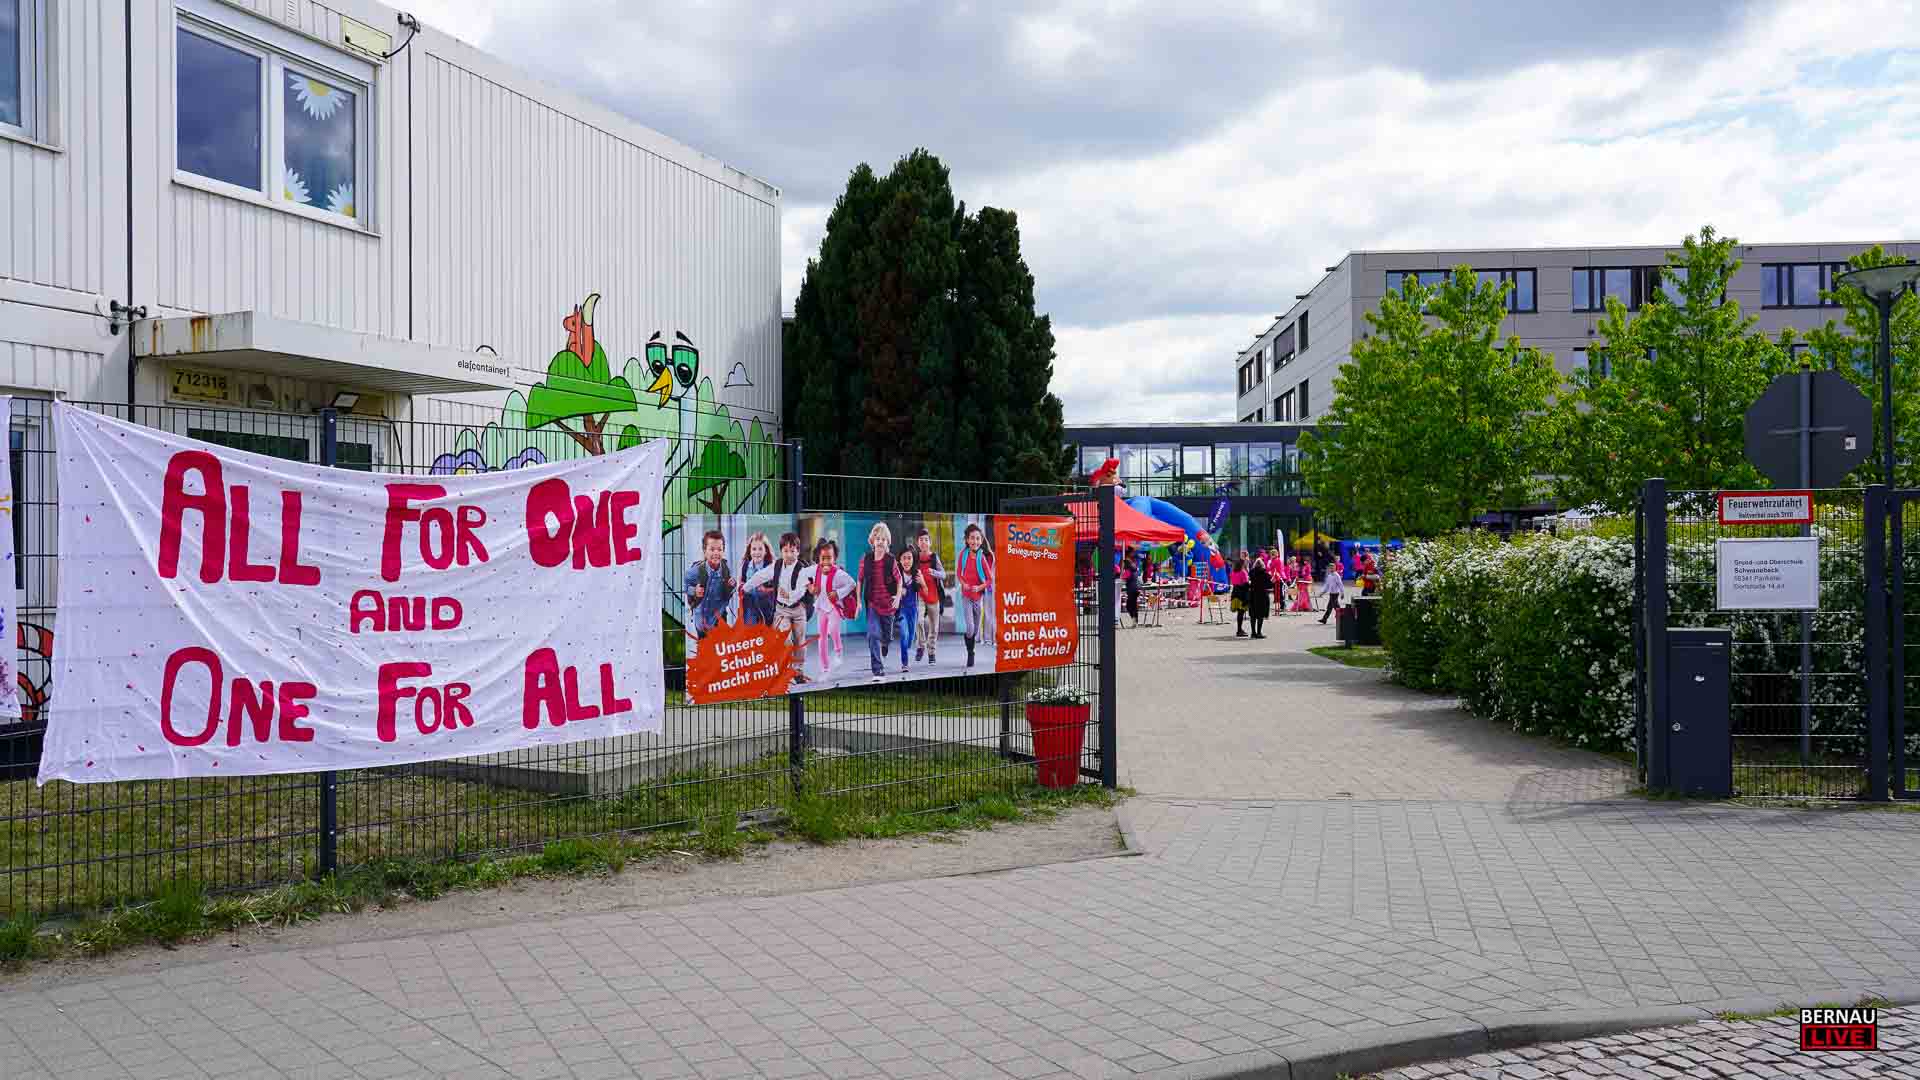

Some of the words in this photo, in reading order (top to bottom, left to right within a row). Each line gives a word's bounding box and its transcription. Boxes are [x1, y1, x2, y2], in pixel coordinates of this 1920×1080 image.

[458, 360, 510, 377] ela[container]
[1728, 497, 1803, 510] Feuerwehrzufahrt
[158, 449, 321, 586] ALL
[380, 483, 489, 583] FOR
[525, 478, 642, 571] ONE
[1007, 544, 1059, 560] Bewegungs-Pass
[1003, 592, 1027, 606] Wir
[349, 589, 463, 634] AND
[1003, 608, 1057, 624] kommen
[1003, 626, 1036, 643] ohne
[1038, 625, 1069, 640] Auto
[715, 636, 764, 656] Unsere
[1003, 647, 1024, 660] zur
[1027, 641, 1072, 657] Schule!
[720, 651, 764, 673] Schule
[707, 671, 751, 693] macht
[753, 663, 779, 680] mit!
[160, 646, 318, 748] ONE
[376, 661, 473, 743] FOR
[522, 647, 633, 730] ALL
